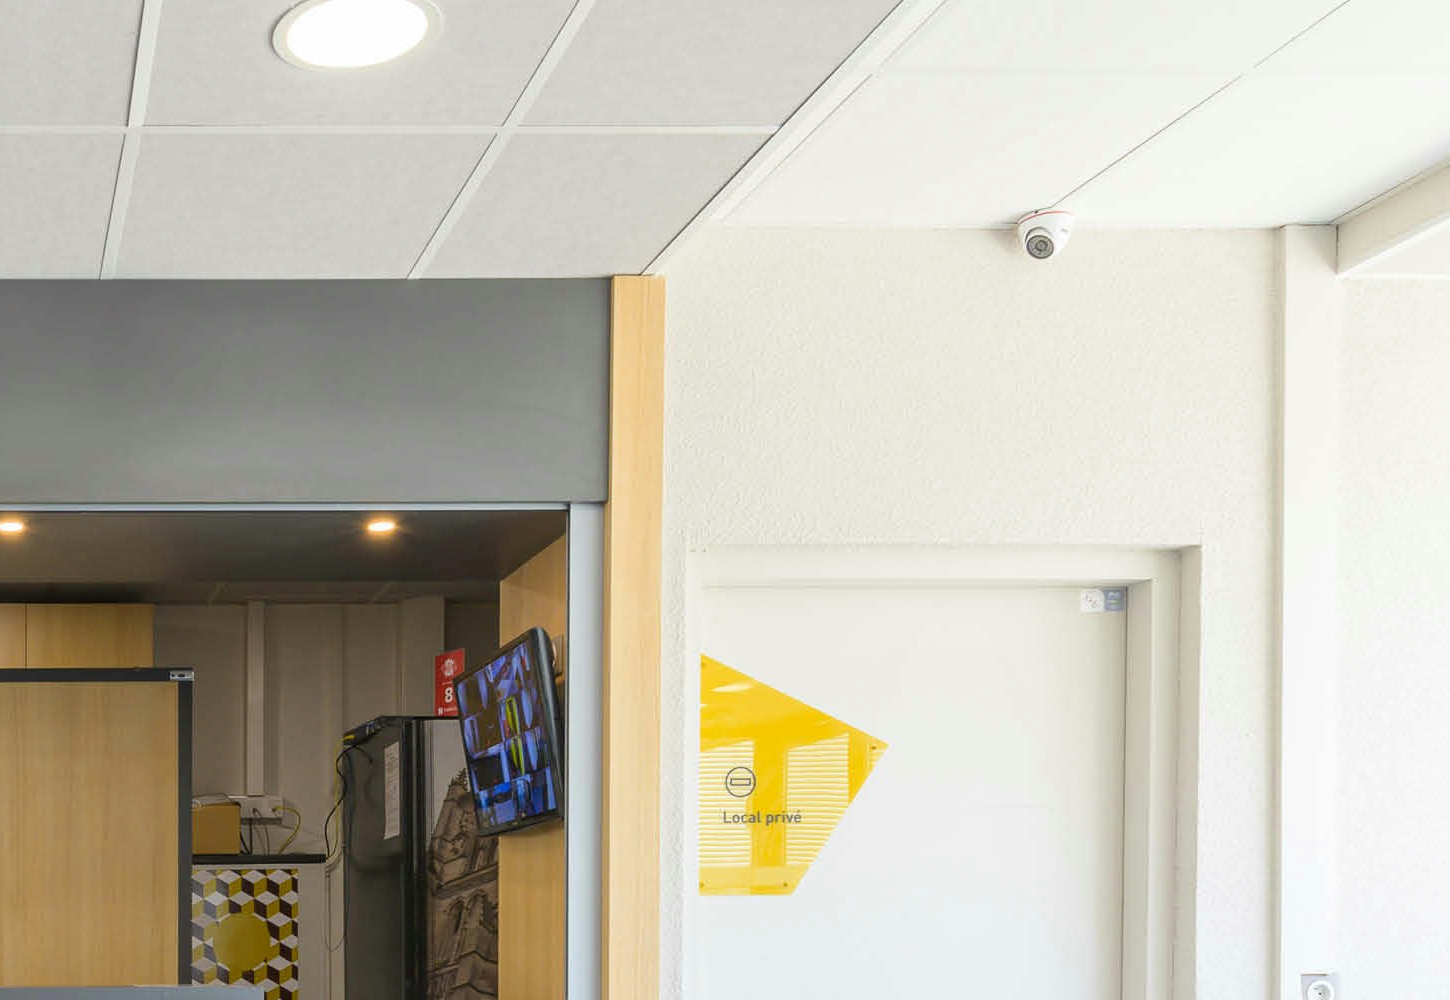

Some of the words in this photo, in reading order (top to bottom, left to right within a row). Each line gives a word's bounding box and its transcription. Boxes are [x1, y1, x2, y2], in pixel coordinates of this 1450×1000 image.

[445, 687, 453, 703] 8
[723, 811, 761, 824] Local
[766, 810, 802, 826] privé
